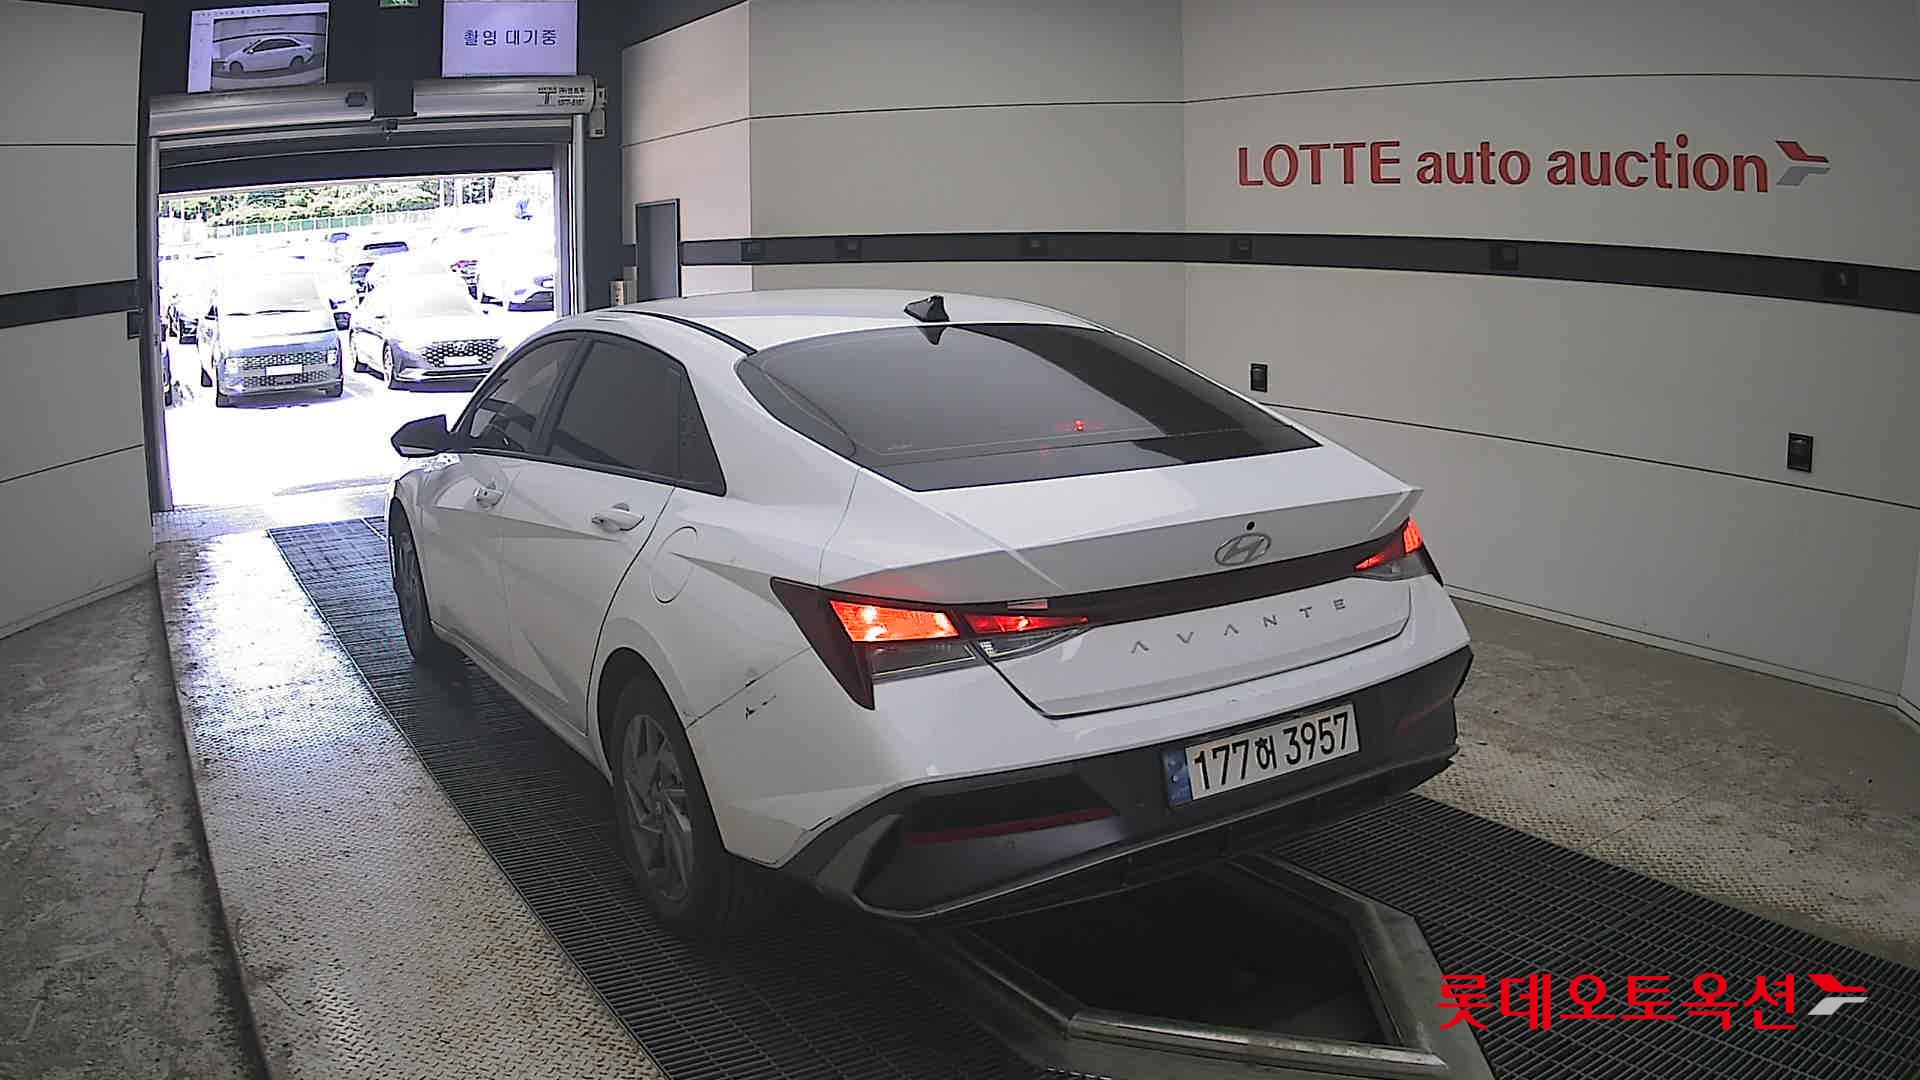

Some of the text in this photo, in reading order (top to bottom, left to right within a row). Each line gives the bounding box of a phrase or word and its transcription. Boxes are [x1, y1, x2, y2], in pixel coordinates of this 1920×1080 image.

[464, 29, 556, 46] 촬영 대기중
[1239, 134, 1769, 193] LOTTE auto auction
[1131, 598, 1347, 655] AVANTE
[1194, 711, 1349, 791] 177허 3957
